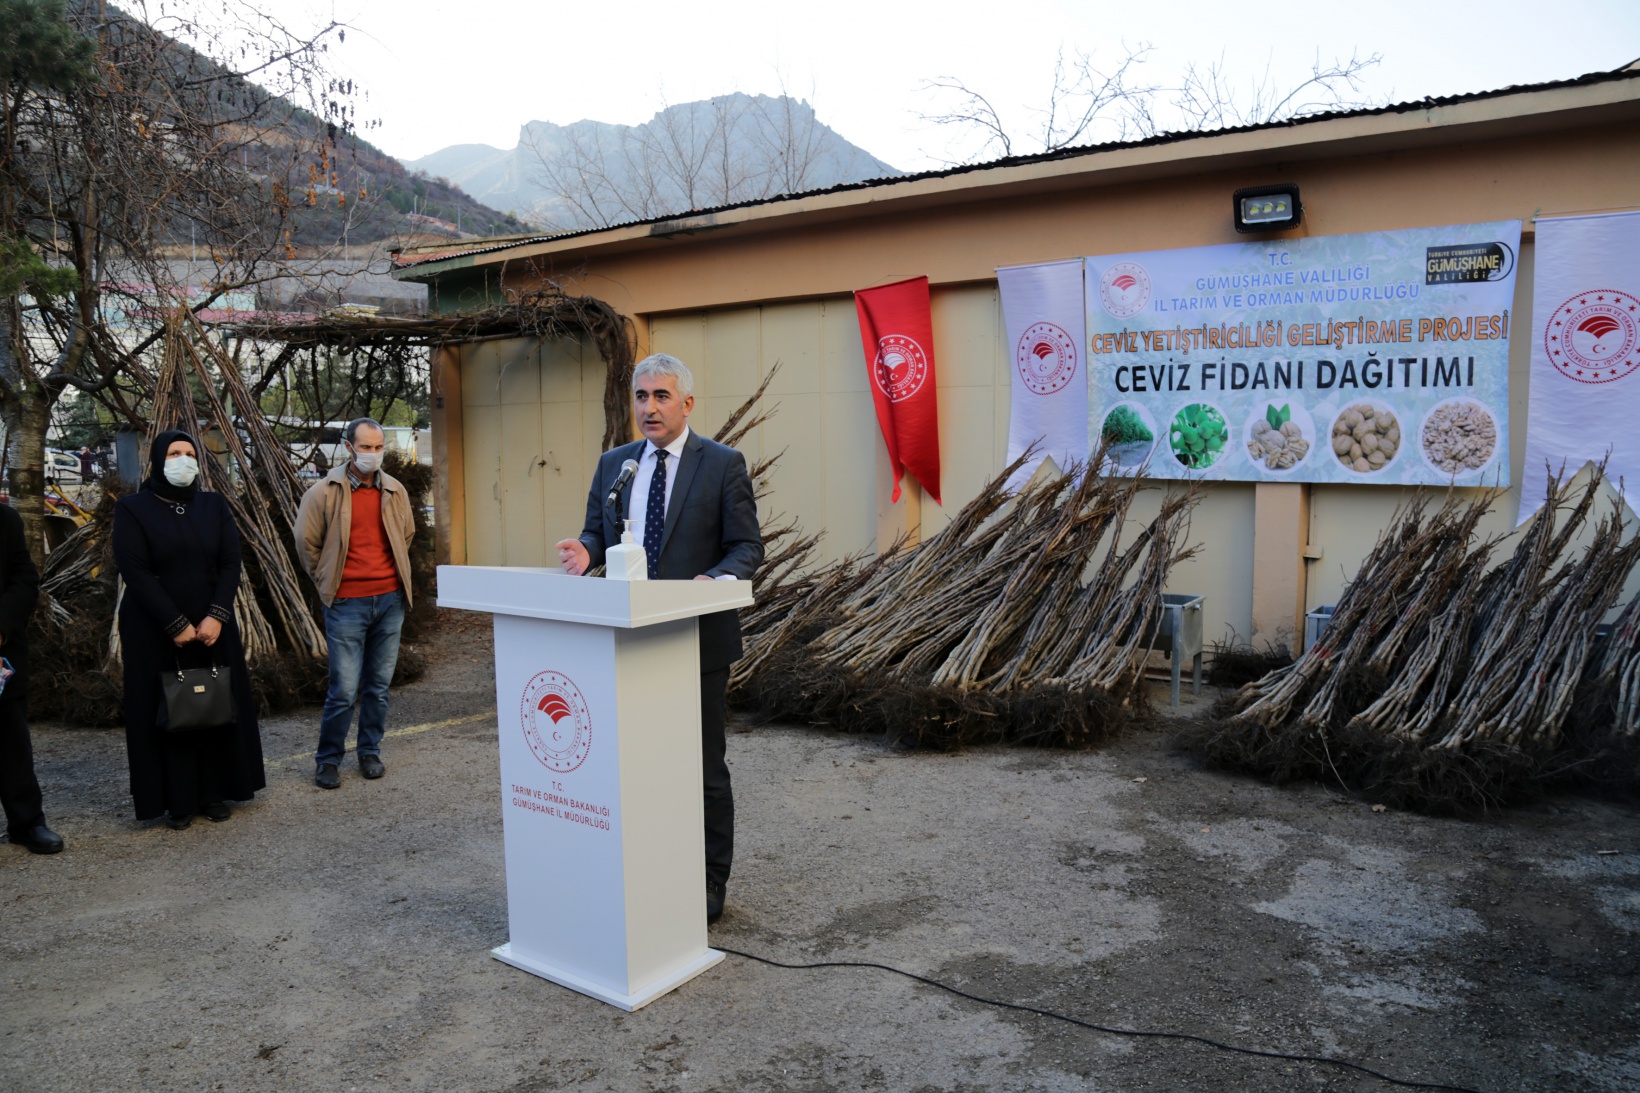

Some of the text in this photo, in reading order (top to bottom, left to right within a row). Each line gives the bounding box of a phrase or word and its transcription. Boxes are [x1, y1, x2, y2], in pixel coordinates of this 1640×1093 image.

[1268, 252, 1293, 267] T.C.
[1427, 254, 1500, 273] GÜMÜŞHANE
[1196, 263, 1370, 291] GÜMÜŞHANE VALİLİĞİ
[1154, 280, 1420, 312] İL TARIM VE ORMAN MÜDÜRLÜĞÜ
[1091, 310, 1508, 355] CEVİZ YETİŞTİRİCİLİĞİ GELİŞTİRME PROJESİ
[1115, 350, 1475, 392] CEVİZ FİDANI DAĞITIMI
[511, 784, 610, 817] TARIM VE ORMAN BAKANLIĞI
[551, 781, 565, 792] T.C.
[512, 797, 610, 831] GÜMÜŞHANE İL MÜDÜRLÜĞÜ
